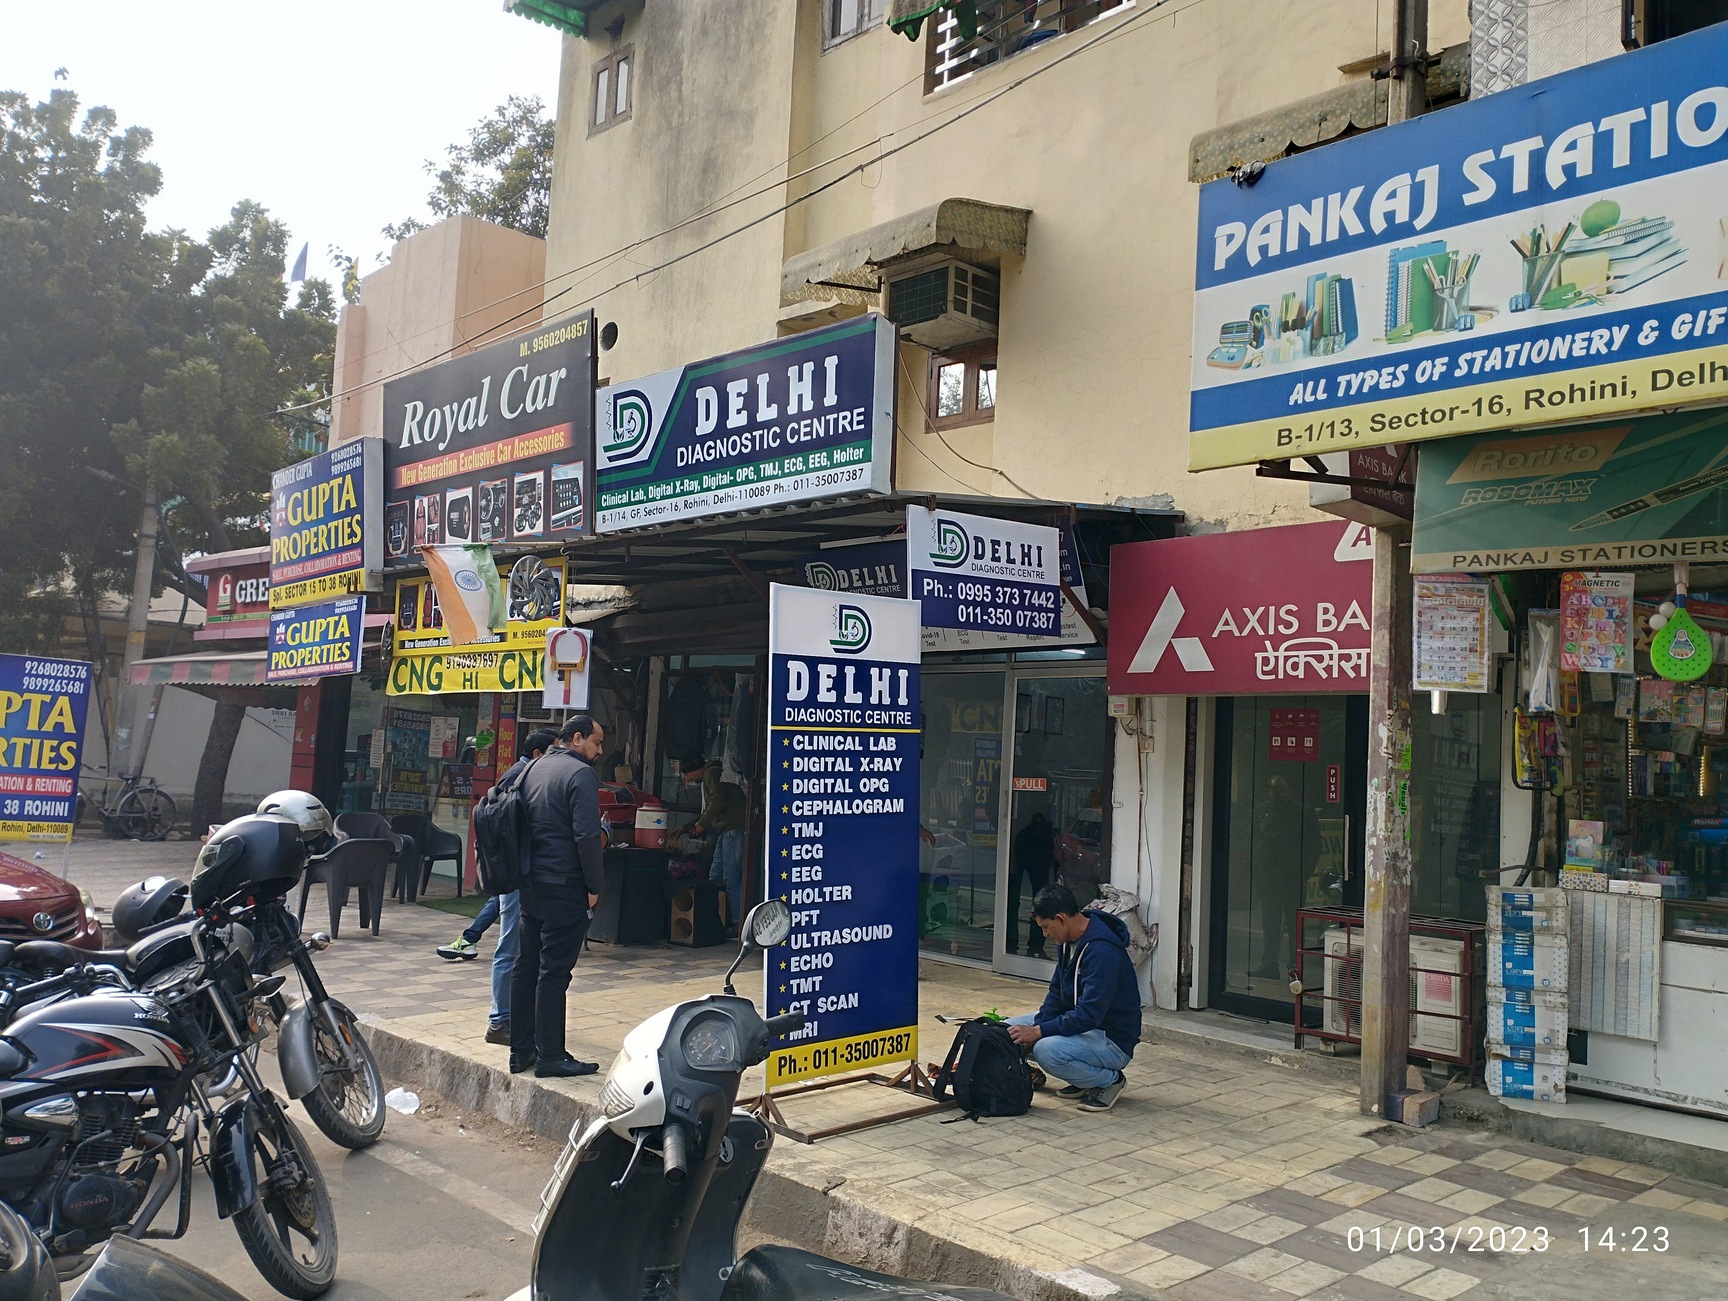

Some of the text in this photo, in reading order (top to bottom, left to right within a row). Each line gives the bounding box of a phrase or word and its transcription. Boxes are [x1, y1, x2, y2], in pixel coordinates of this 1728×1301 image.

[1213, 165, 1440, 271] PANKAJ
[520, 320, 589, 357] M. 9560204857
[1288, 307, 1728, 406] ALL TYPES OF STATIONERY & GIF
[695, 355, 839, 436] DELHI
[399, 364, 567, 451] Royal Car
[1276, 418, 1360, 448] B-1/13,
[1368, 396, 1512, 435] Sector-16,
[1524, 376, 1638, 411] Rohini,
[676, 407, 865, 468] DIAGNOSTIC CENTRE
[331, 456, 362, 476] 9899265681
[401, 430, 565, 485] New Generation Exclusive Car Accessories
[1472, 442, 1598, 473] Rorito
[272, 461, 312, 490] CHANDER GUPTA
[602, 448, 864, 507] Clinical Lab, Digital X-Ray, Digital- OPG, TMJ, ECG, EEG, Holter
[1358, 454, 1407, 484] AXIS BAK
[287, 474, 358, 526] GUPTA
[602, 511, 628, 524] B-1/14,
[630, 507, 642, 520] GF,
[643, 500, 682, 517] Sector-16,
[683, 497, 710, 511] Rohini,
[713, 485, 771, 506] Delhi-110089
[793, 468, 864, 492] 011-35007387
[1461, 478, 1598, 505] ROBOMAX
[1564, 495, 1589, 504] NOW
[272, 514, 362, 565] PROPERTIES
[973, 536, 1044, 568] DELHI
[1452, 550, 1549, 568] PANKAJ
[838, 564, 898, 588] DELHI
[971, 562, 1045, 580] DIAGNOSTIC CENTRE
[272, 590, 283, 602] Spl.
[284, 582, 307, 600] SECTOR
[309, 580, 316, 594] 15
[318, 578, 327, 592] TO
[328, 575, 336, 590] 38
[876, 584, 901, 594] CENTRE
[923, 578, 1055, 608] Ph.: 0995 373 7442
[1574, 580, 1620, 588] MAGNETIC
[958, 604, 1055, 630] 011-350 07387
[1211, 603, 1299, 638] AXIS
[286, 614, 350, 646] GUPTA
[520, 630, 546, 638] 9560204
[996, 634, 1008, 642] Test
[404, 636, 452, 648] New Generation Exclu
[926, 640, 936, 648] Test
[271, 642, 350, 670] PROPERTIES
[446, 653, 499, 670] 9140387697
[24, 660, 88, 679] 9268028576
[392, 651, 545, 693] CNG HI CN
[22, 676, 84, 694] 9899265681
[786, 660, 909, 706] DELHI
[0, 690, 77, 734] PTA
[785, 707, 912, 725] DIAGNOSTIC CENTRE
[498, 745, 512, 758] Flat
[792, 735, 897, 752] CLINICAL LAB
[792, 757, 903, 772] DIGITAL X-RAY
[26, 778, 33, 791] &
[35, 778, 72, 793] RENTING
[792, 778, 890, 794] DIGITAL OPG
[1020, 779, 1044, 789] PULL
[4, 800, 69, 817] 38 ROHINI
[792, 798, 904, 816] CEPHALOGRAM
[1, 822, 68, 834] Rohini, Delhi-110089
[792, 822, 824, 838] TMJ
[1694, 818, 1720, 826] Rorito
[791, 844, 824, 861] ECG
[791, 865, 822, 884] EEG
[791, 884, 853, 906] HOLTER
[791, 910, 820, 928] PFT
[790, 924, 894, 950] ULTRASOUND
[790, 952, 834, 973] ECHO
[790, 976, 822, 996] TMT
[1426, 973, 1450, 983] ONIDA
[817, 992, 859, 1014] SCAN
[777, 1032, 912, 1077] Ph.: 011-35007387
[70, 1196, 108, 1208] HONDA
